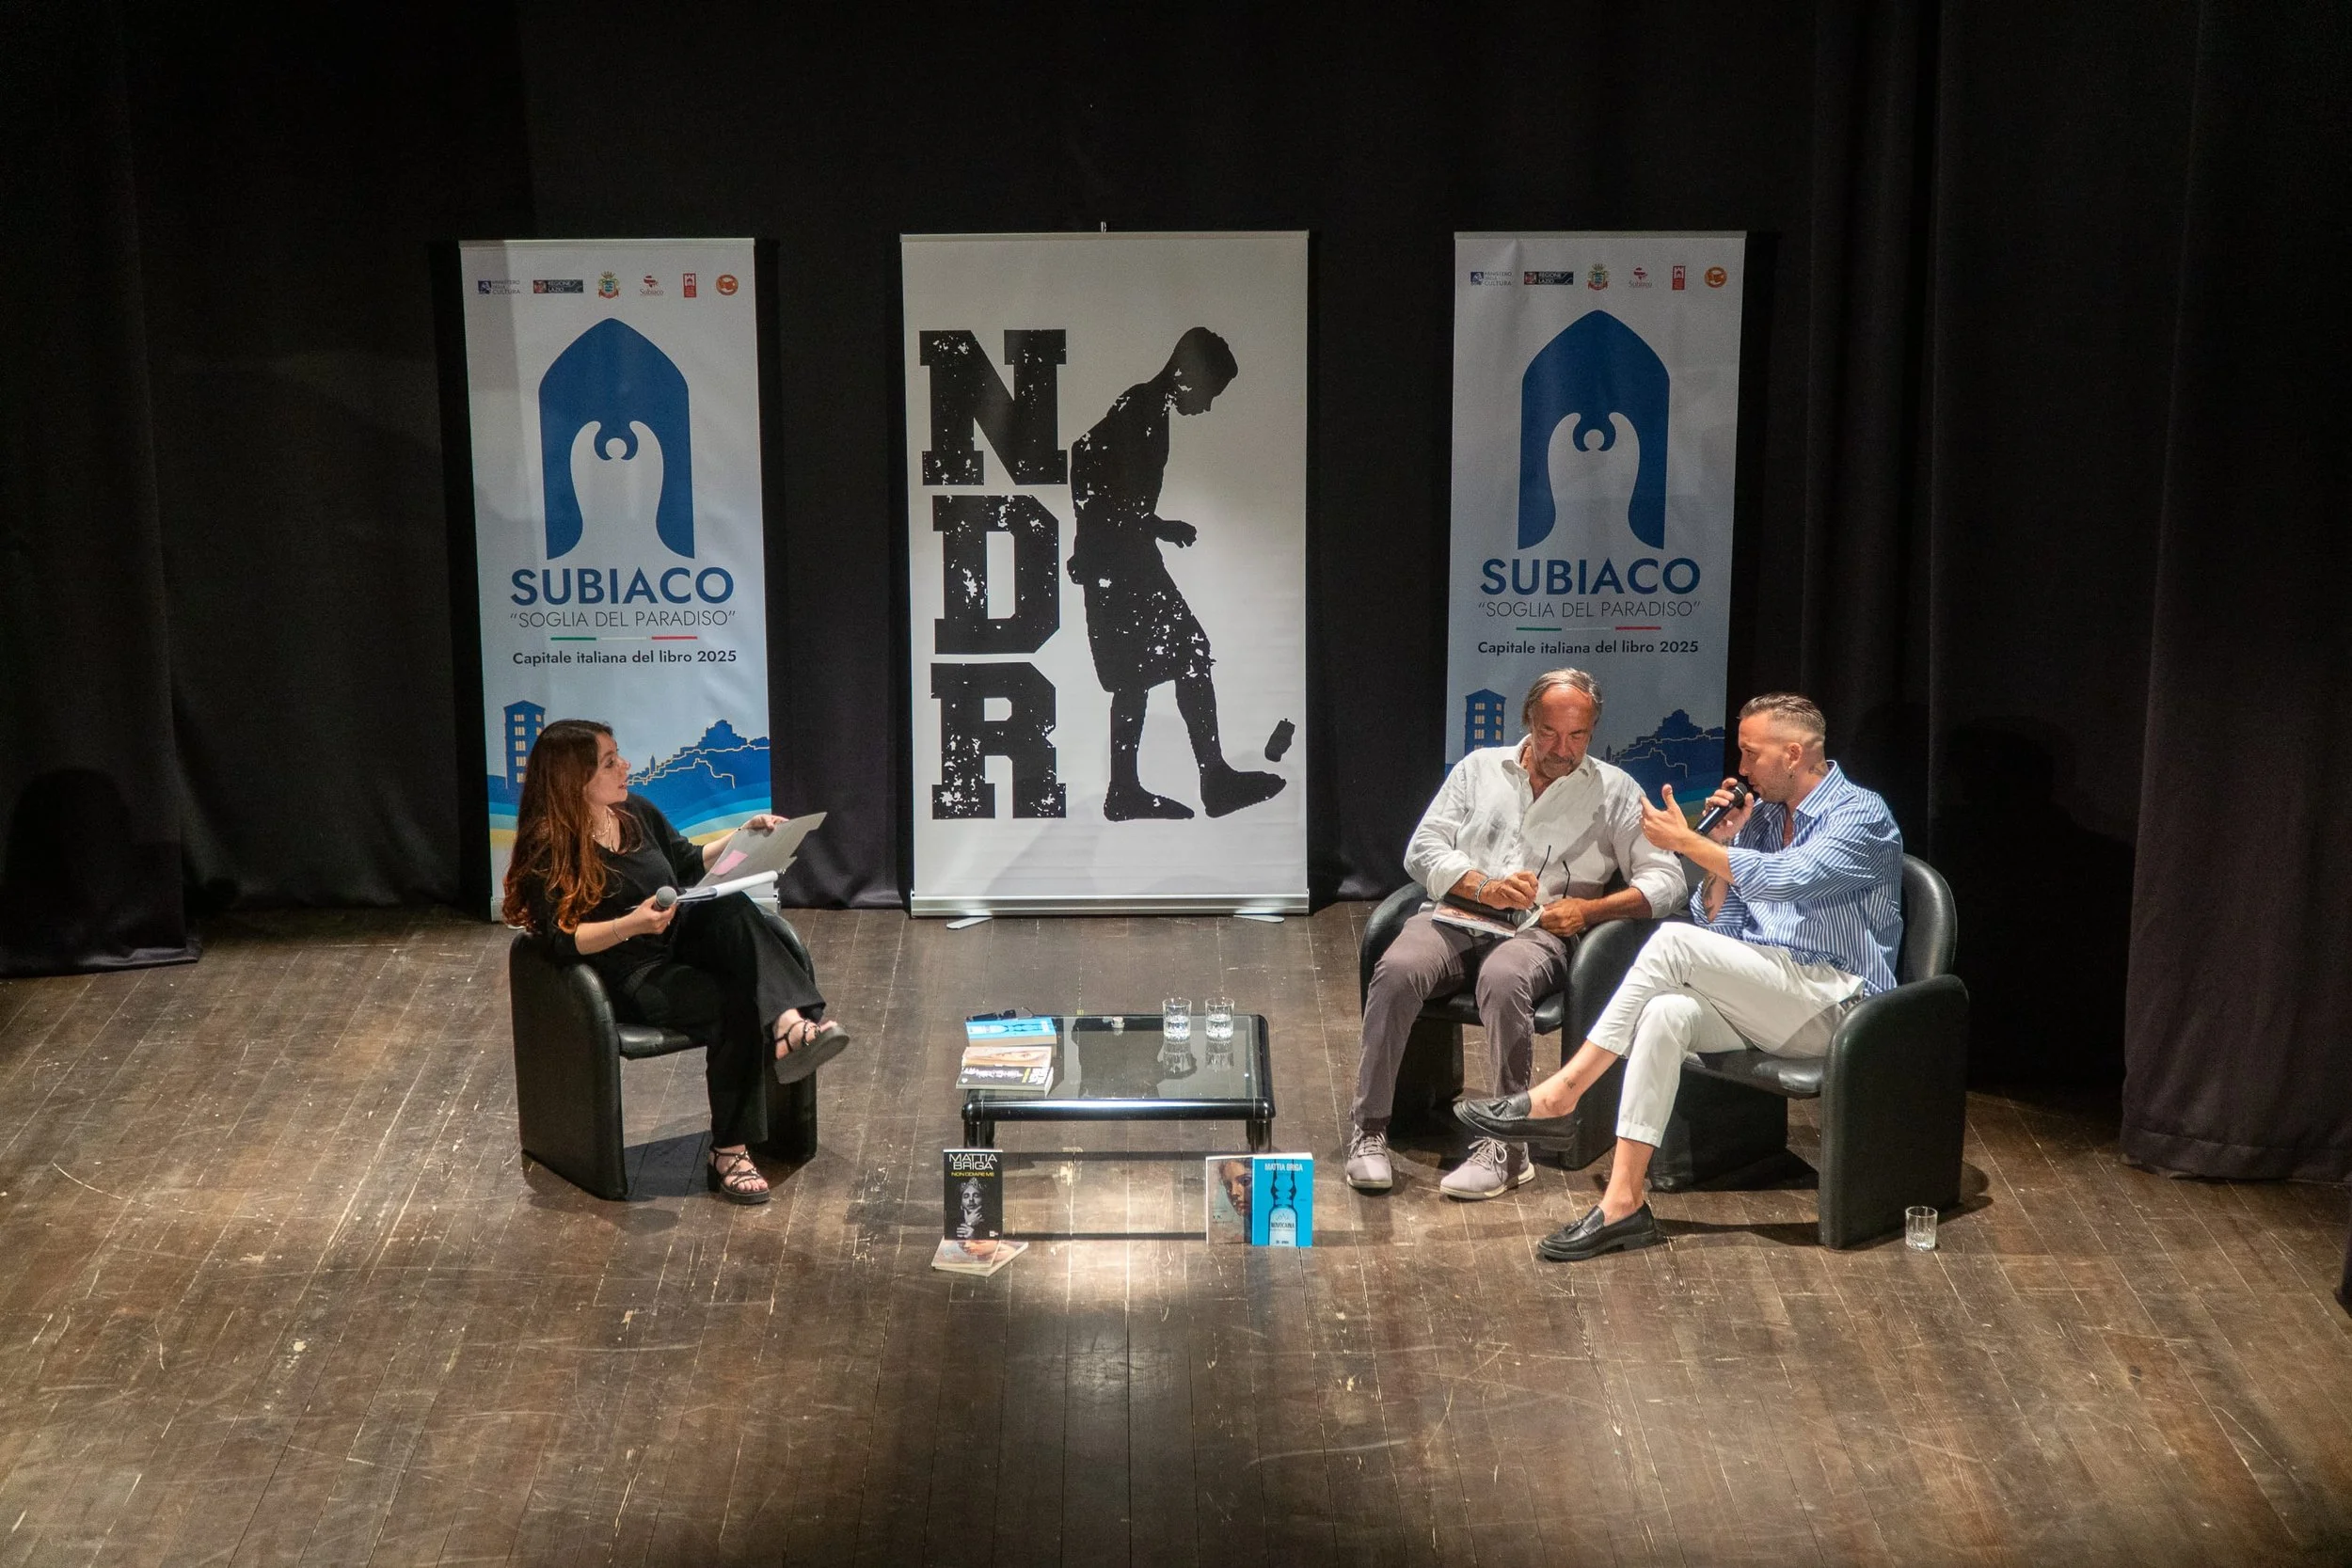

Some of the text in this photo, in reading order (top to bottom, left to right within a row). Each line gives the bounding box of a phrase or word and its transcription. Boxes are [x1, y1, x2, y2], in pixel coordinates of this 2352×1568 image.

[639, 288, 664, 296] Subiaco
[1480, 557, 1701, 595] SUBIACO
[510, 566, 734, 606] SUBIACO
[1562, 602, 1595, 618] DEL
[596, 611, 628, 627] DEL
[1478, 641, 1699, 657] Capitale italiana del libro 2025
[513, 650, 737, 667] Capitale italiana del libro 2025
[948, 1153, 998, 1163] MATTIA
[953, 1162, 993, 1170] BRIGA
